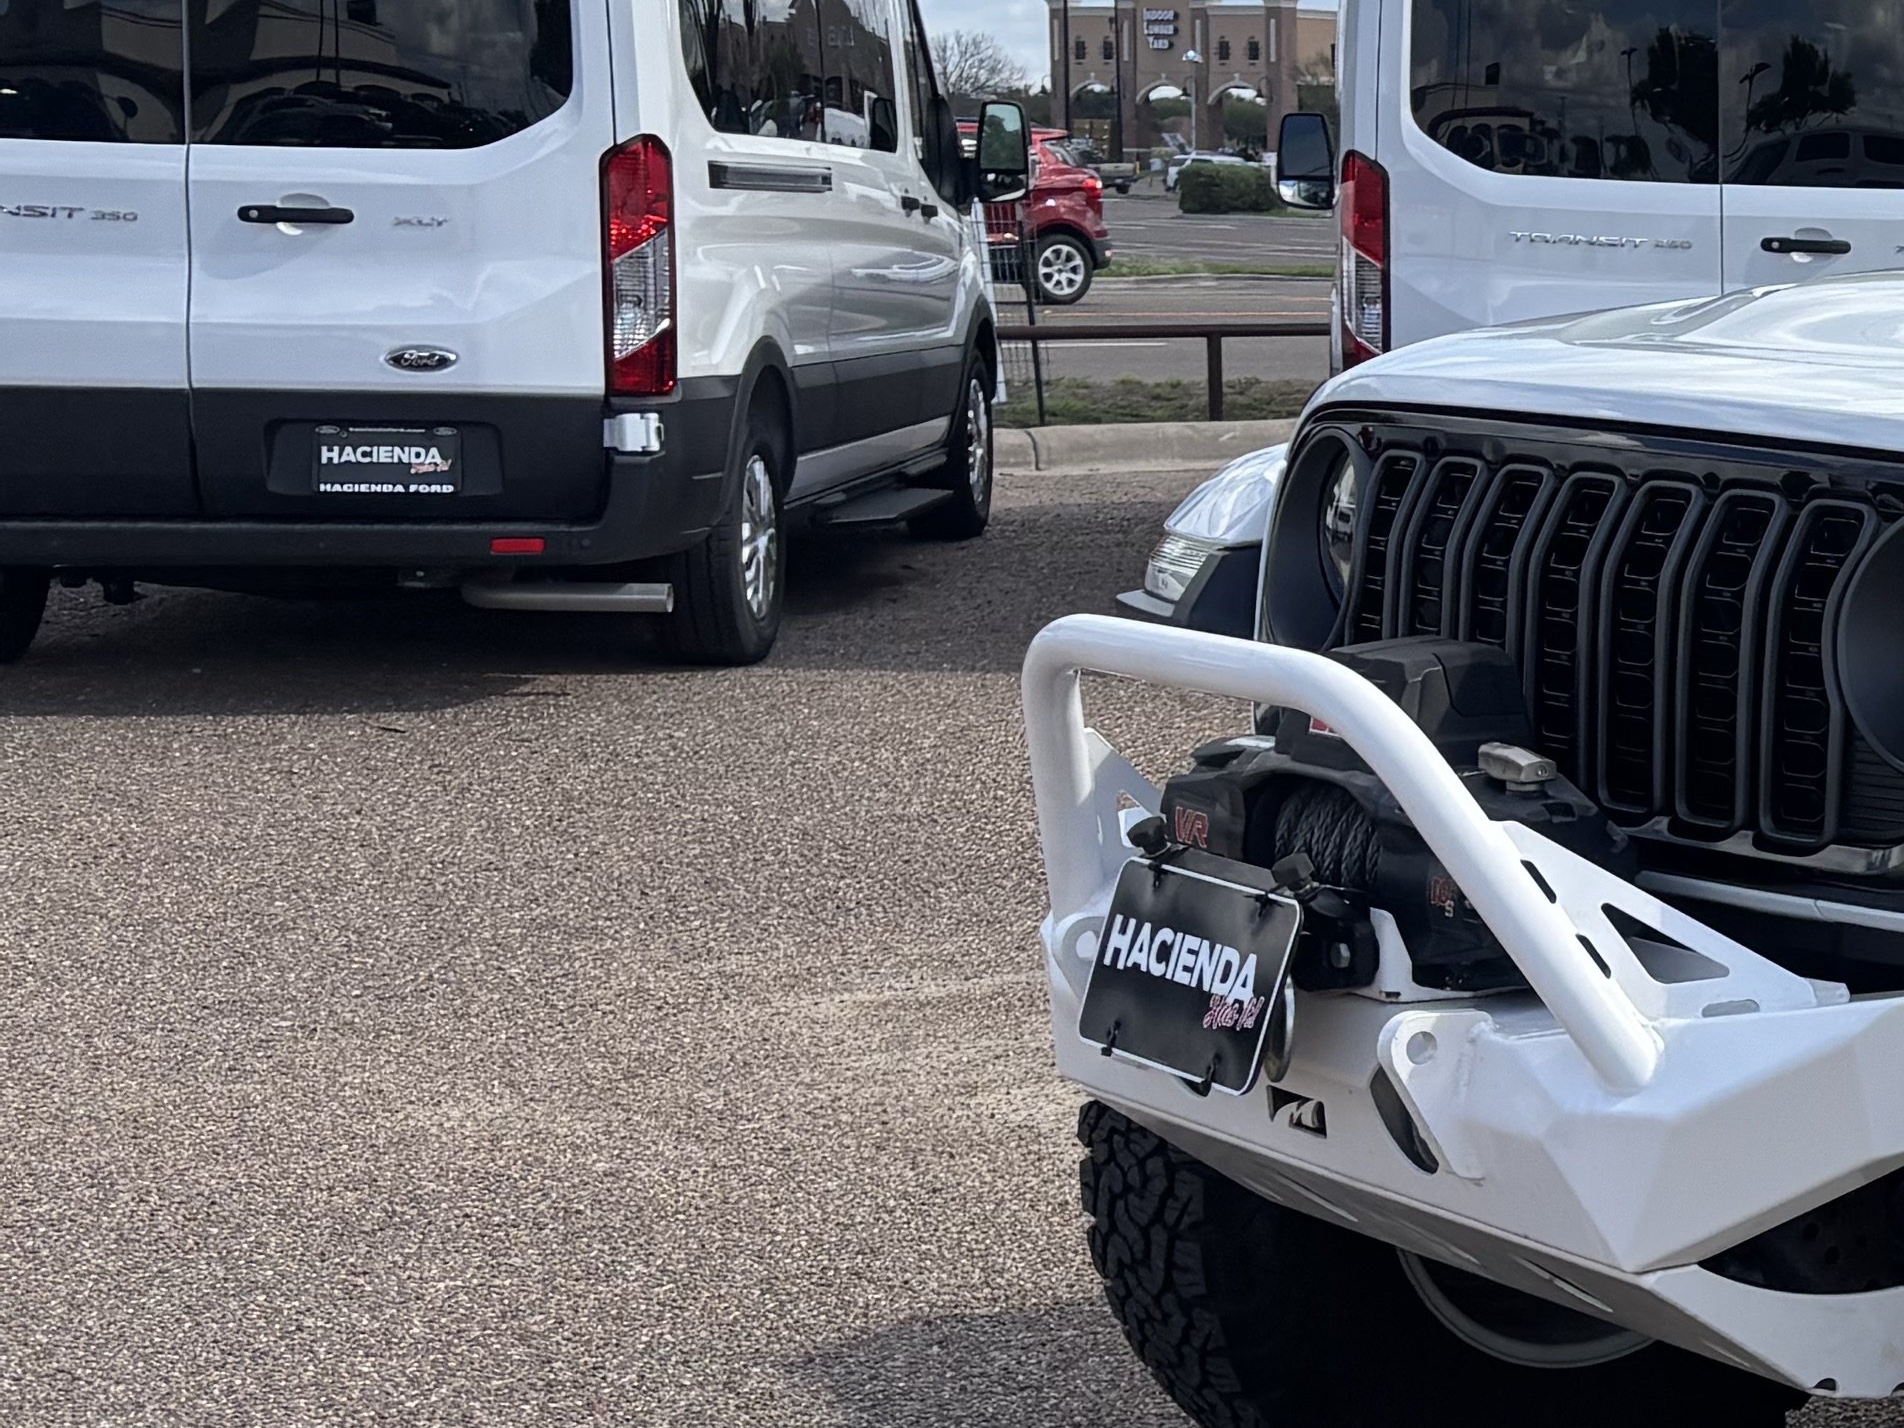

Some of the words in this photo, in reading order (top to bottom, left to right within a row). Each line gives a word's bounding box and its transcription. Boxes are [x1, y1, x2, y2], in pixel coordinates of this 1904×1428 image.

[1509, 231, 1648, 249] TRANSIT
[320, 445, 442, 464] HACIENDA
[319, 483, 406, 494] HACIENDA
[408, 484, 455, 494] FORD
[1174, 805, 1210, 848] VR
[1103, 913, 1258, 1003] HACIENDA
